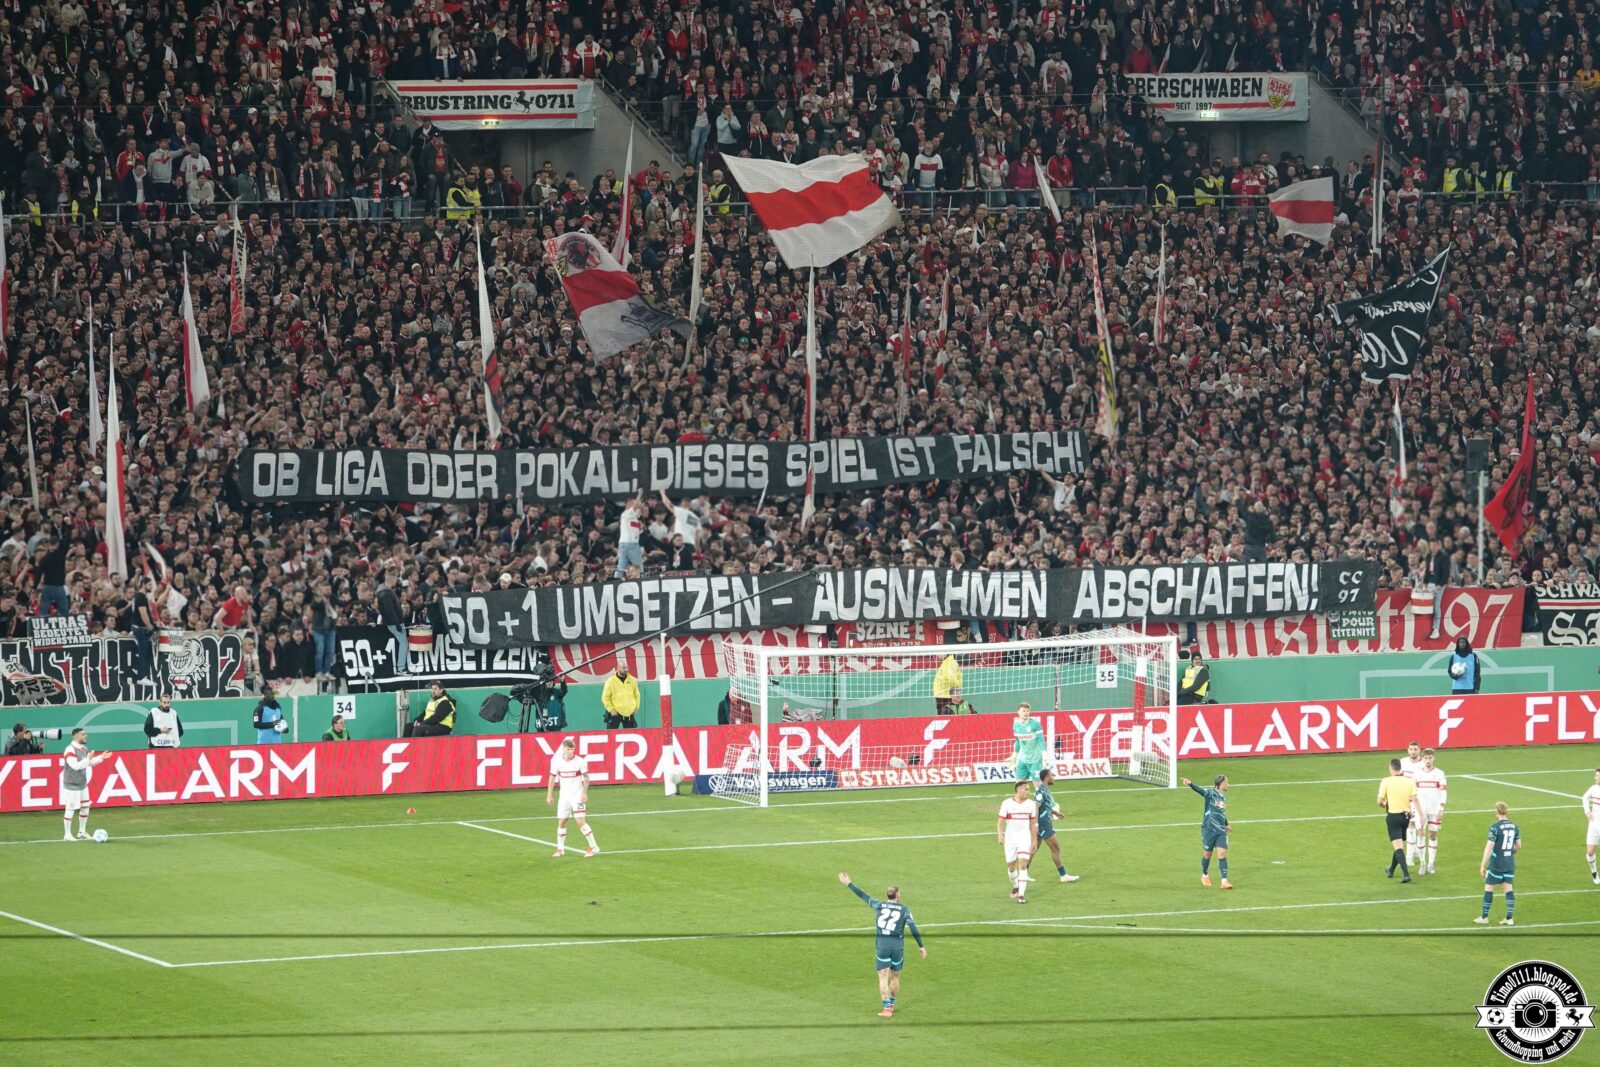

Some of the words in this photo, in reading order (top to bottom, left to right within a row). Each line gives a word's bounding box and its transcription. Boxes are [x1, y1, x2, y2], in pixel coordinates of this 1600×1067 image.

[535, 93, 575, 109] 0711
[1175, 102, 1191, 111] SEIT
[1196, 102, 1213, 111] 1997
[253, 452, 300, 497] OB
[315, 450, 389, 496] LIGA
[407, 452, 498, 499] ODER
[515, 449, 638, 499] POKAL:
[650, 444, 769, 491] DIESES
[786, 438, 878, 488] SPIEL
[887, 437, 936, 478] IST
[952, 431, 1084, 474] FALSCH!
[1339, 571, 1363, 585] CC
[557, 575, 761, 640] UMSETZEN
[812, 567, 1047, 621] AUSNAHMEN
[1073, 563, 1319, 618] ABSCHAFFEN!
[1338, 588, 1360, 603] 97
[31, 614, 87, 630] ULTRAS
[1341, 616, 1375, 627] POUR
[1444, 592, 1513, 650] 97
[33, 626, 88, 639] BEDEUTET
[856, 620, 911, 641] SZENE
[34, 635, 92, 647] WIDERSTAND
[1100, 671, 1115, 682] 35
[337, 702, 352, 713] 34
[861, 767, 955, 787] STRAUSS
[1501, 829, 1516, 851] 13
[877, 908, 901, 931] 22
